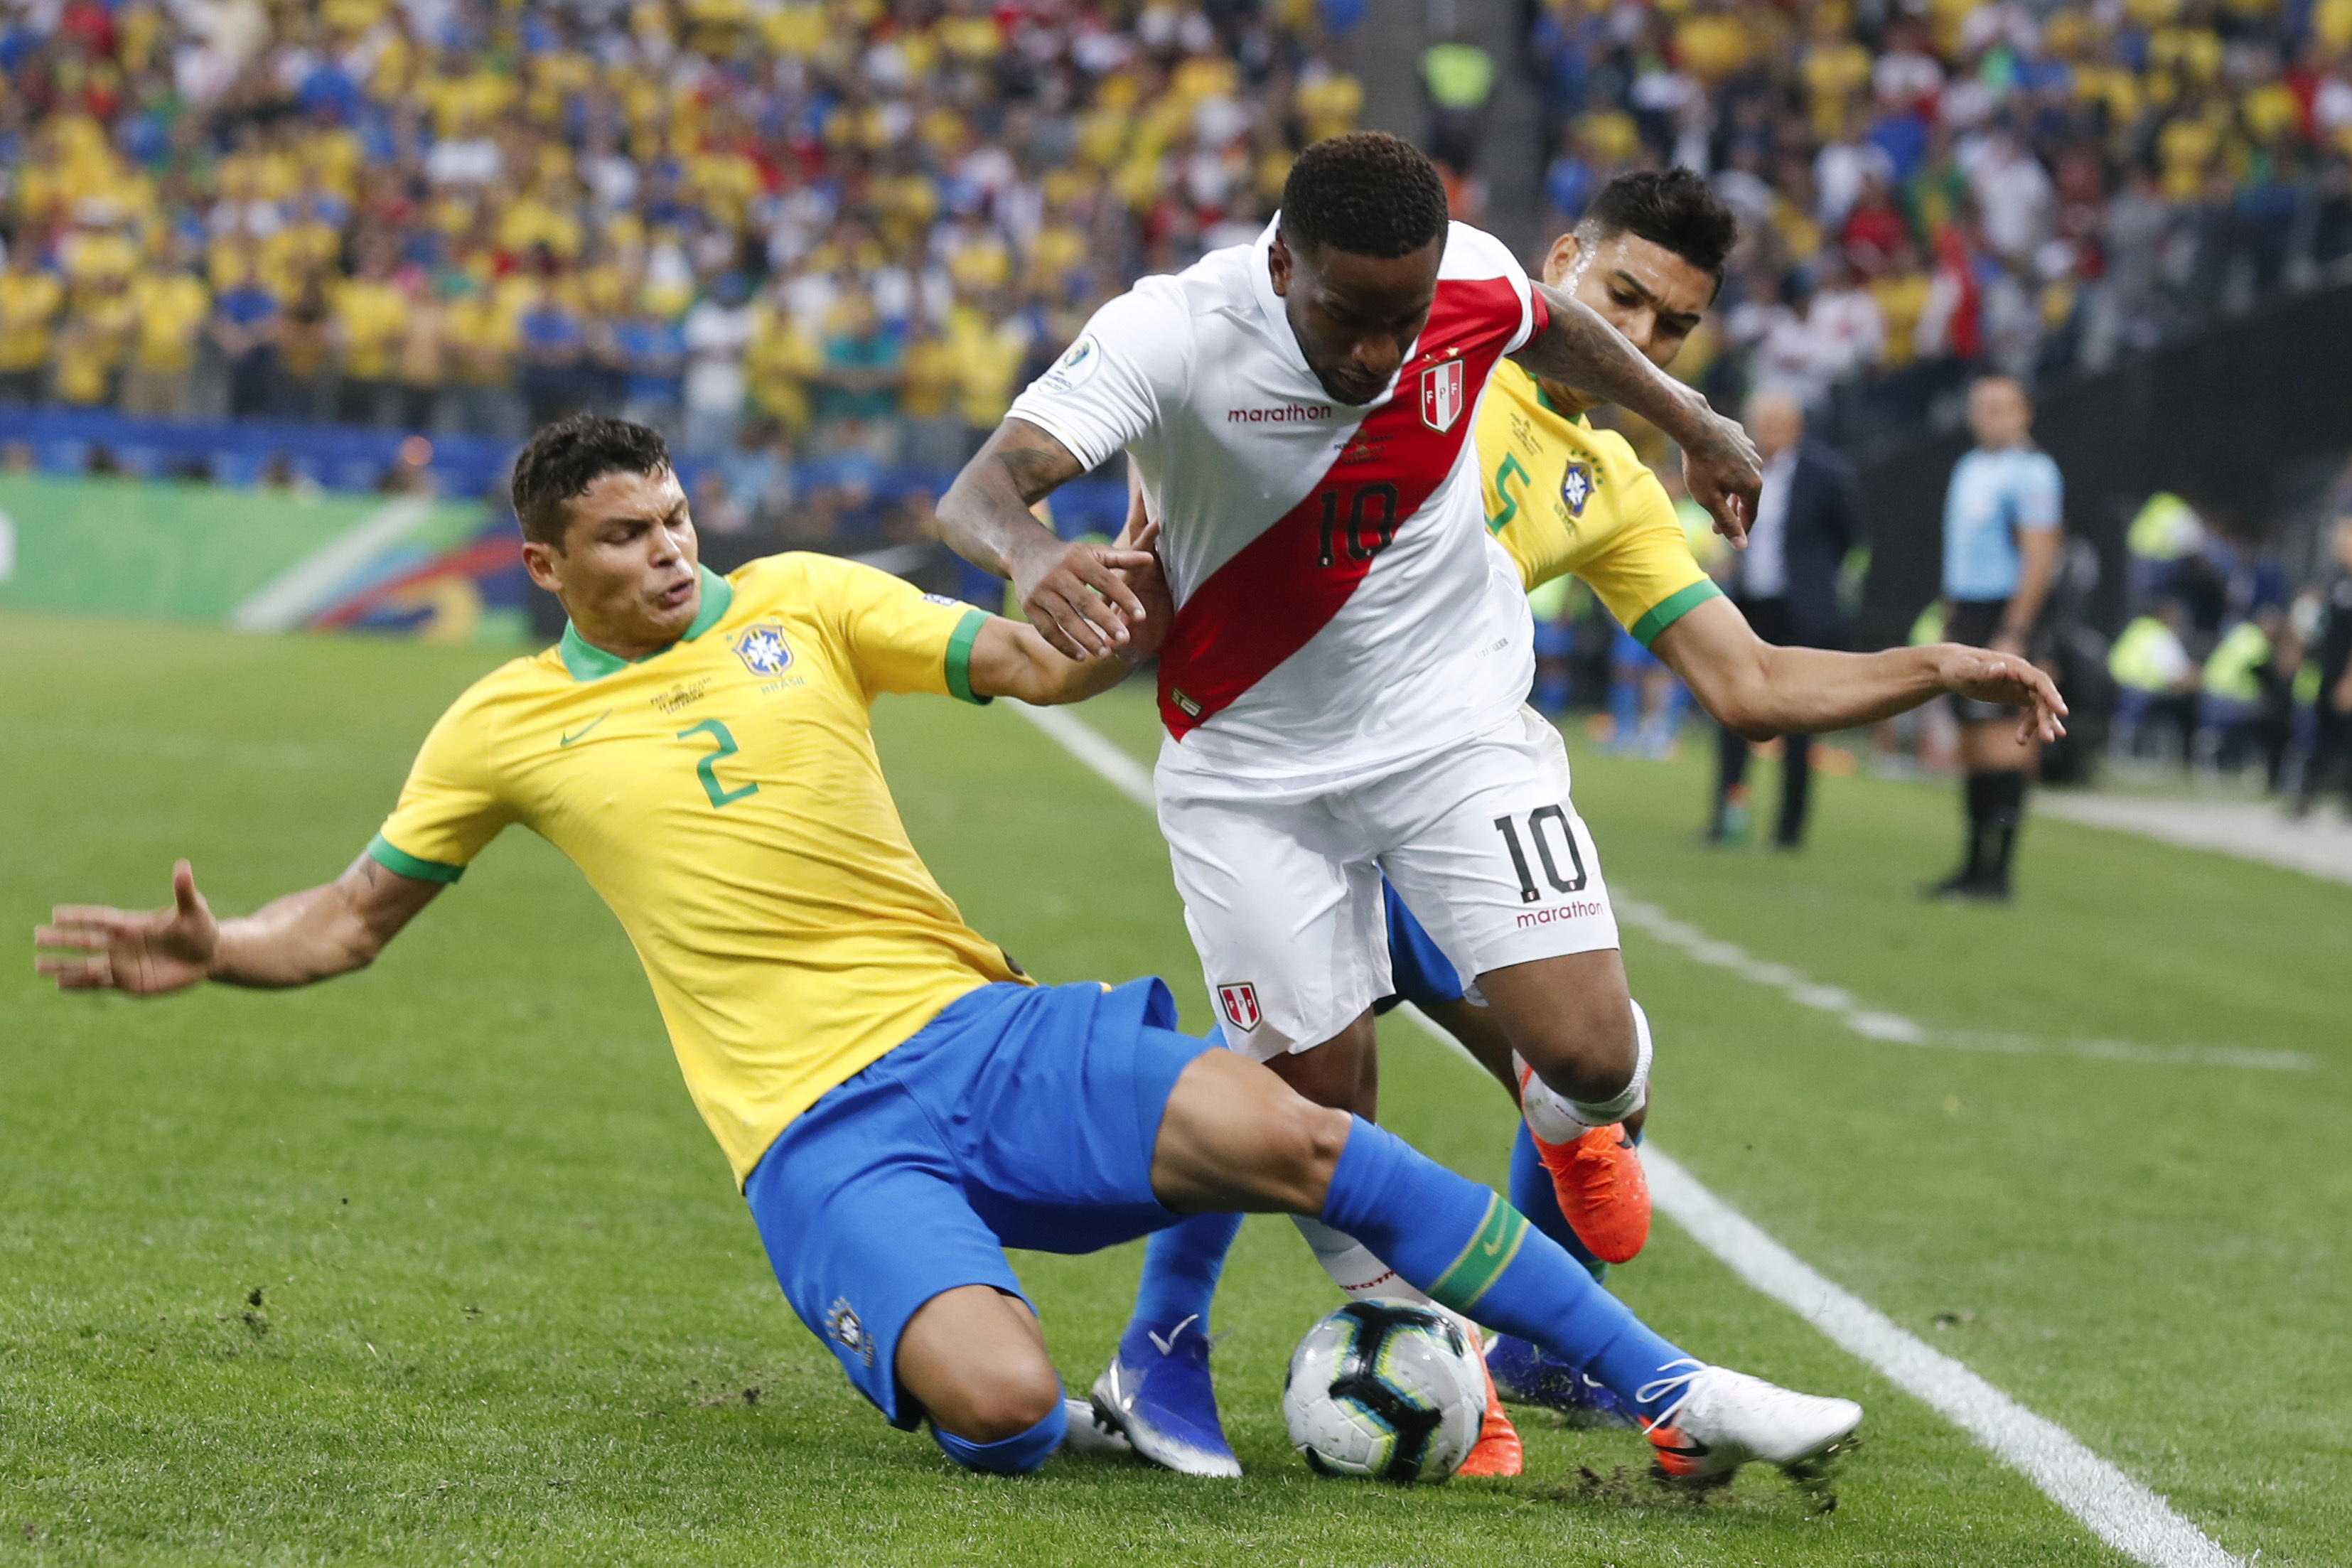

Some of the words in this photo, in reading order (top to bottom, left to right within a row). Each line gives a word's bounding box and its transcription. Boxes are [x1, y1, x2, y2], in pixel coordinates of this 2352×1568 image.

[1228, 403, 1331, 423] marathon
[1316, 483, 1398, 567] 10
[1485, 452, 1530, 535] 5
[677, 718, 759, 809] 2
[1493, 804, 1587, 904] 10
[1516, 901, 1604, 928] marathon
